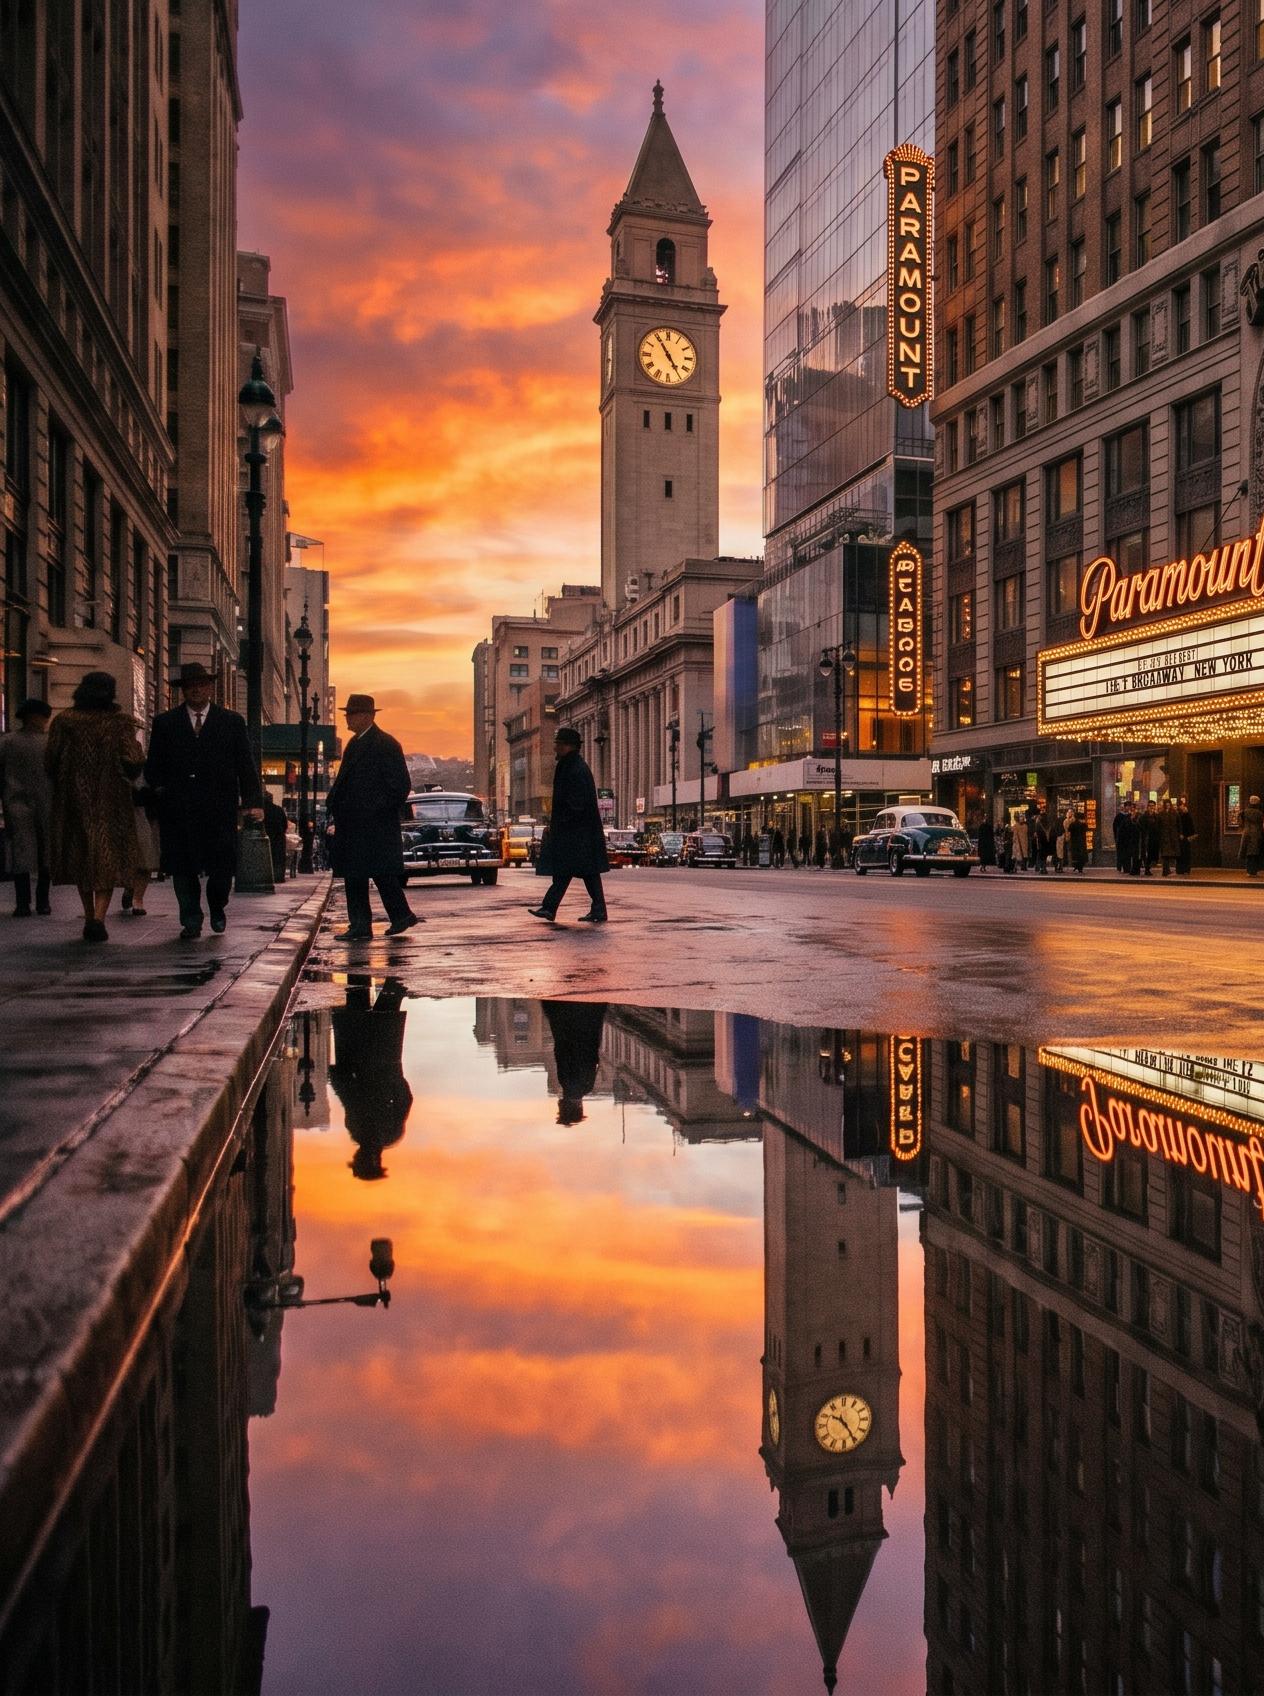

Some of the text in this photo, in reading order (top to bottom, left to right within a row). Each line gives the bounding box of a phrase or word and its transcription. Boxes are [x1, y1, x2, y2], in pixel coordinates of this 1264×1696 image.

[899, 166, 922, 388] PARAMOUNT
[1194, 660, 1217, 677] NEW
[1222, 653, 1253, 673] YORK
